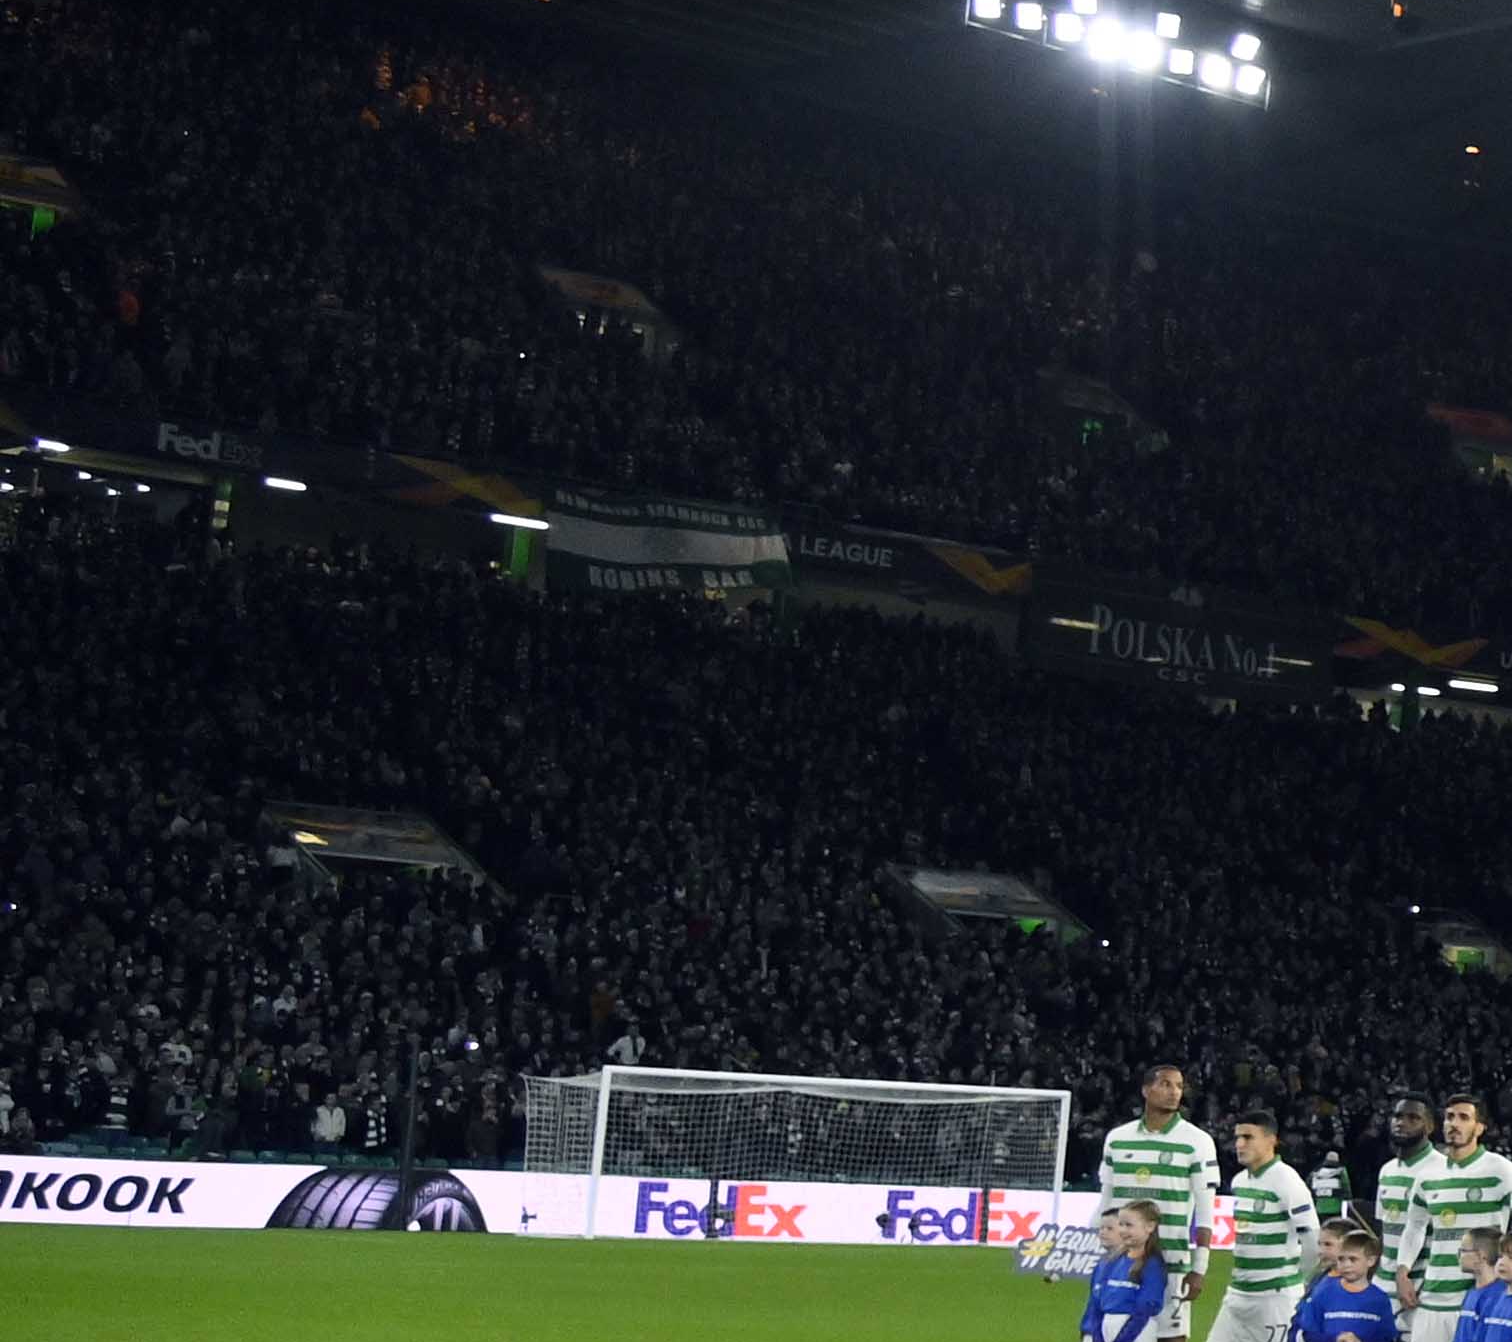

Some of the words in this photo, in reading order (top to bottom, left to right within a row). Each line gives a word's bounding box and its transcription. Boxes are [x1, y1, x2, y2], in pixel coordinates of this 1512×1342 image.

[800, 535, 896, 568] LEAGUE
[1087, 602, 1216, 671] POLSKA
[635, 1181, 806, 1237] FedEx
[886, 1189, 1041, 1243] FedEx
[1043, 1252, 1100, 1275] GAME
[1171, 1295, 1182, 1320] 2
